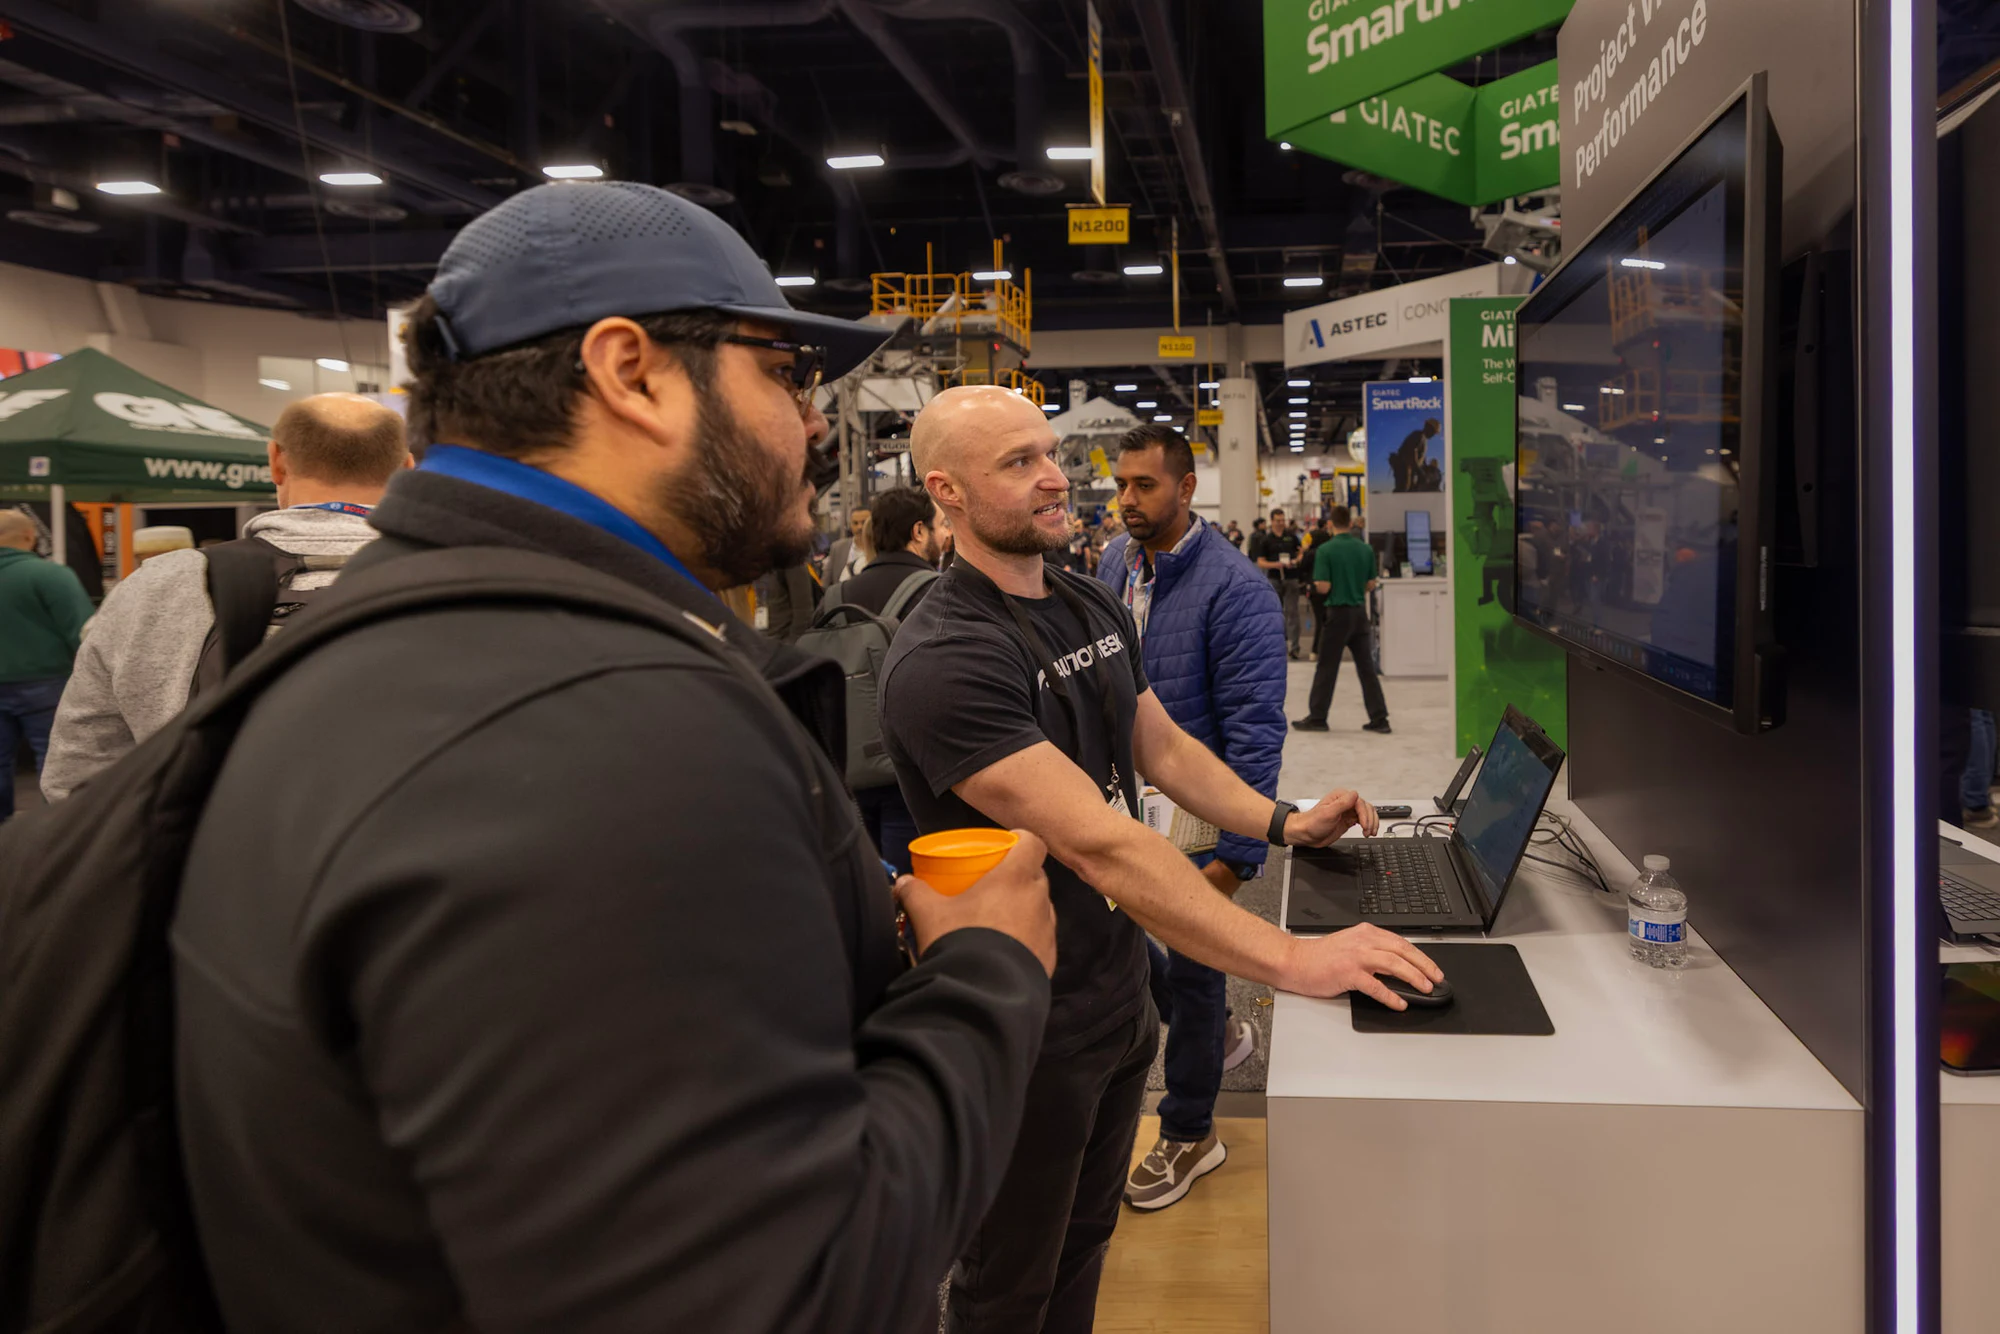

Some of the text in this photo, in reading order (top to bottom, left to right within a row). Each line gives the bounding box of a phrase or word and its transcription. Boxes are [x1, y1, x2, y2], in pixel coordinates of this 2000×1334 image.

[1574, 2, 1636, 126] Project
[1576, 0, 1707, 189] Performance
[1359, 97, 1460, 156] GIATEC
[1500, 119, 1560, 160] Sm
[1072, 220, 1125, 232] N1200
[1330, 312, 1388, 337] ASTEC
[1483, 358, 1504, 369] The
[1372, 396, 1442, 411] SmartRock
